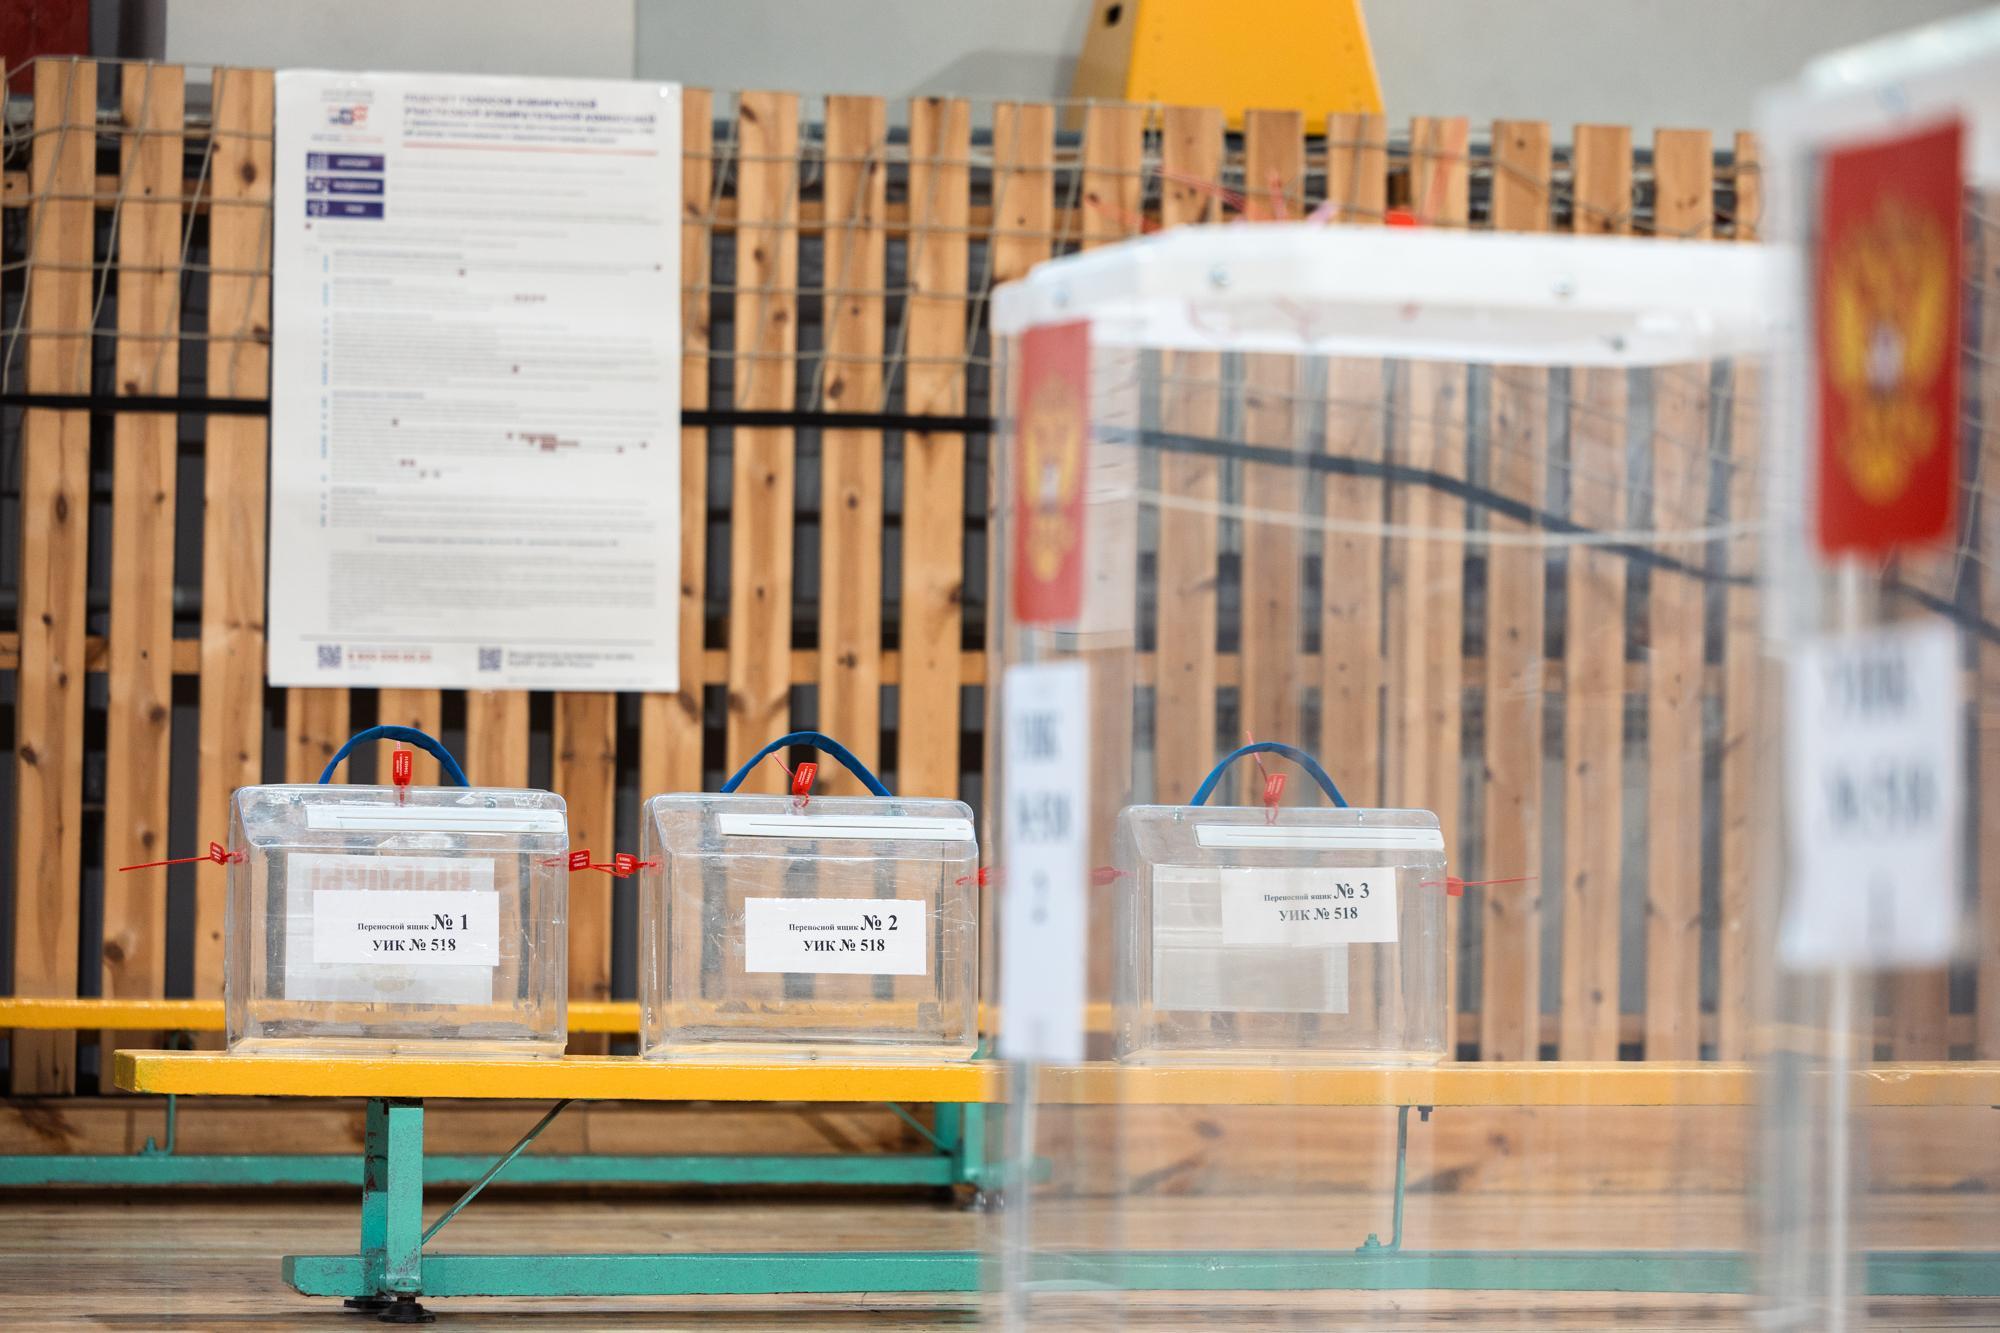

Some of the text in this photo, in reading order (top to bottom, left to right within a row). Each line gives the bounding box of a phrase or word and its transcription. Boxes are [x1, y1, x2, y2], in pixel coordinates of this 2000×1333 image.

[1263, 882, 1370, 903] Переносной ящик № 3
[357, 913, 468, 932] Переносной ящик № 1
[1279, 906, 1359, 922] УИК № 518
[789, 914, 898, 933] Переносной ящик № 2
[372, 938, 456, 952] УИК № 518
[803, 938, 885, 952] УИК № 518
